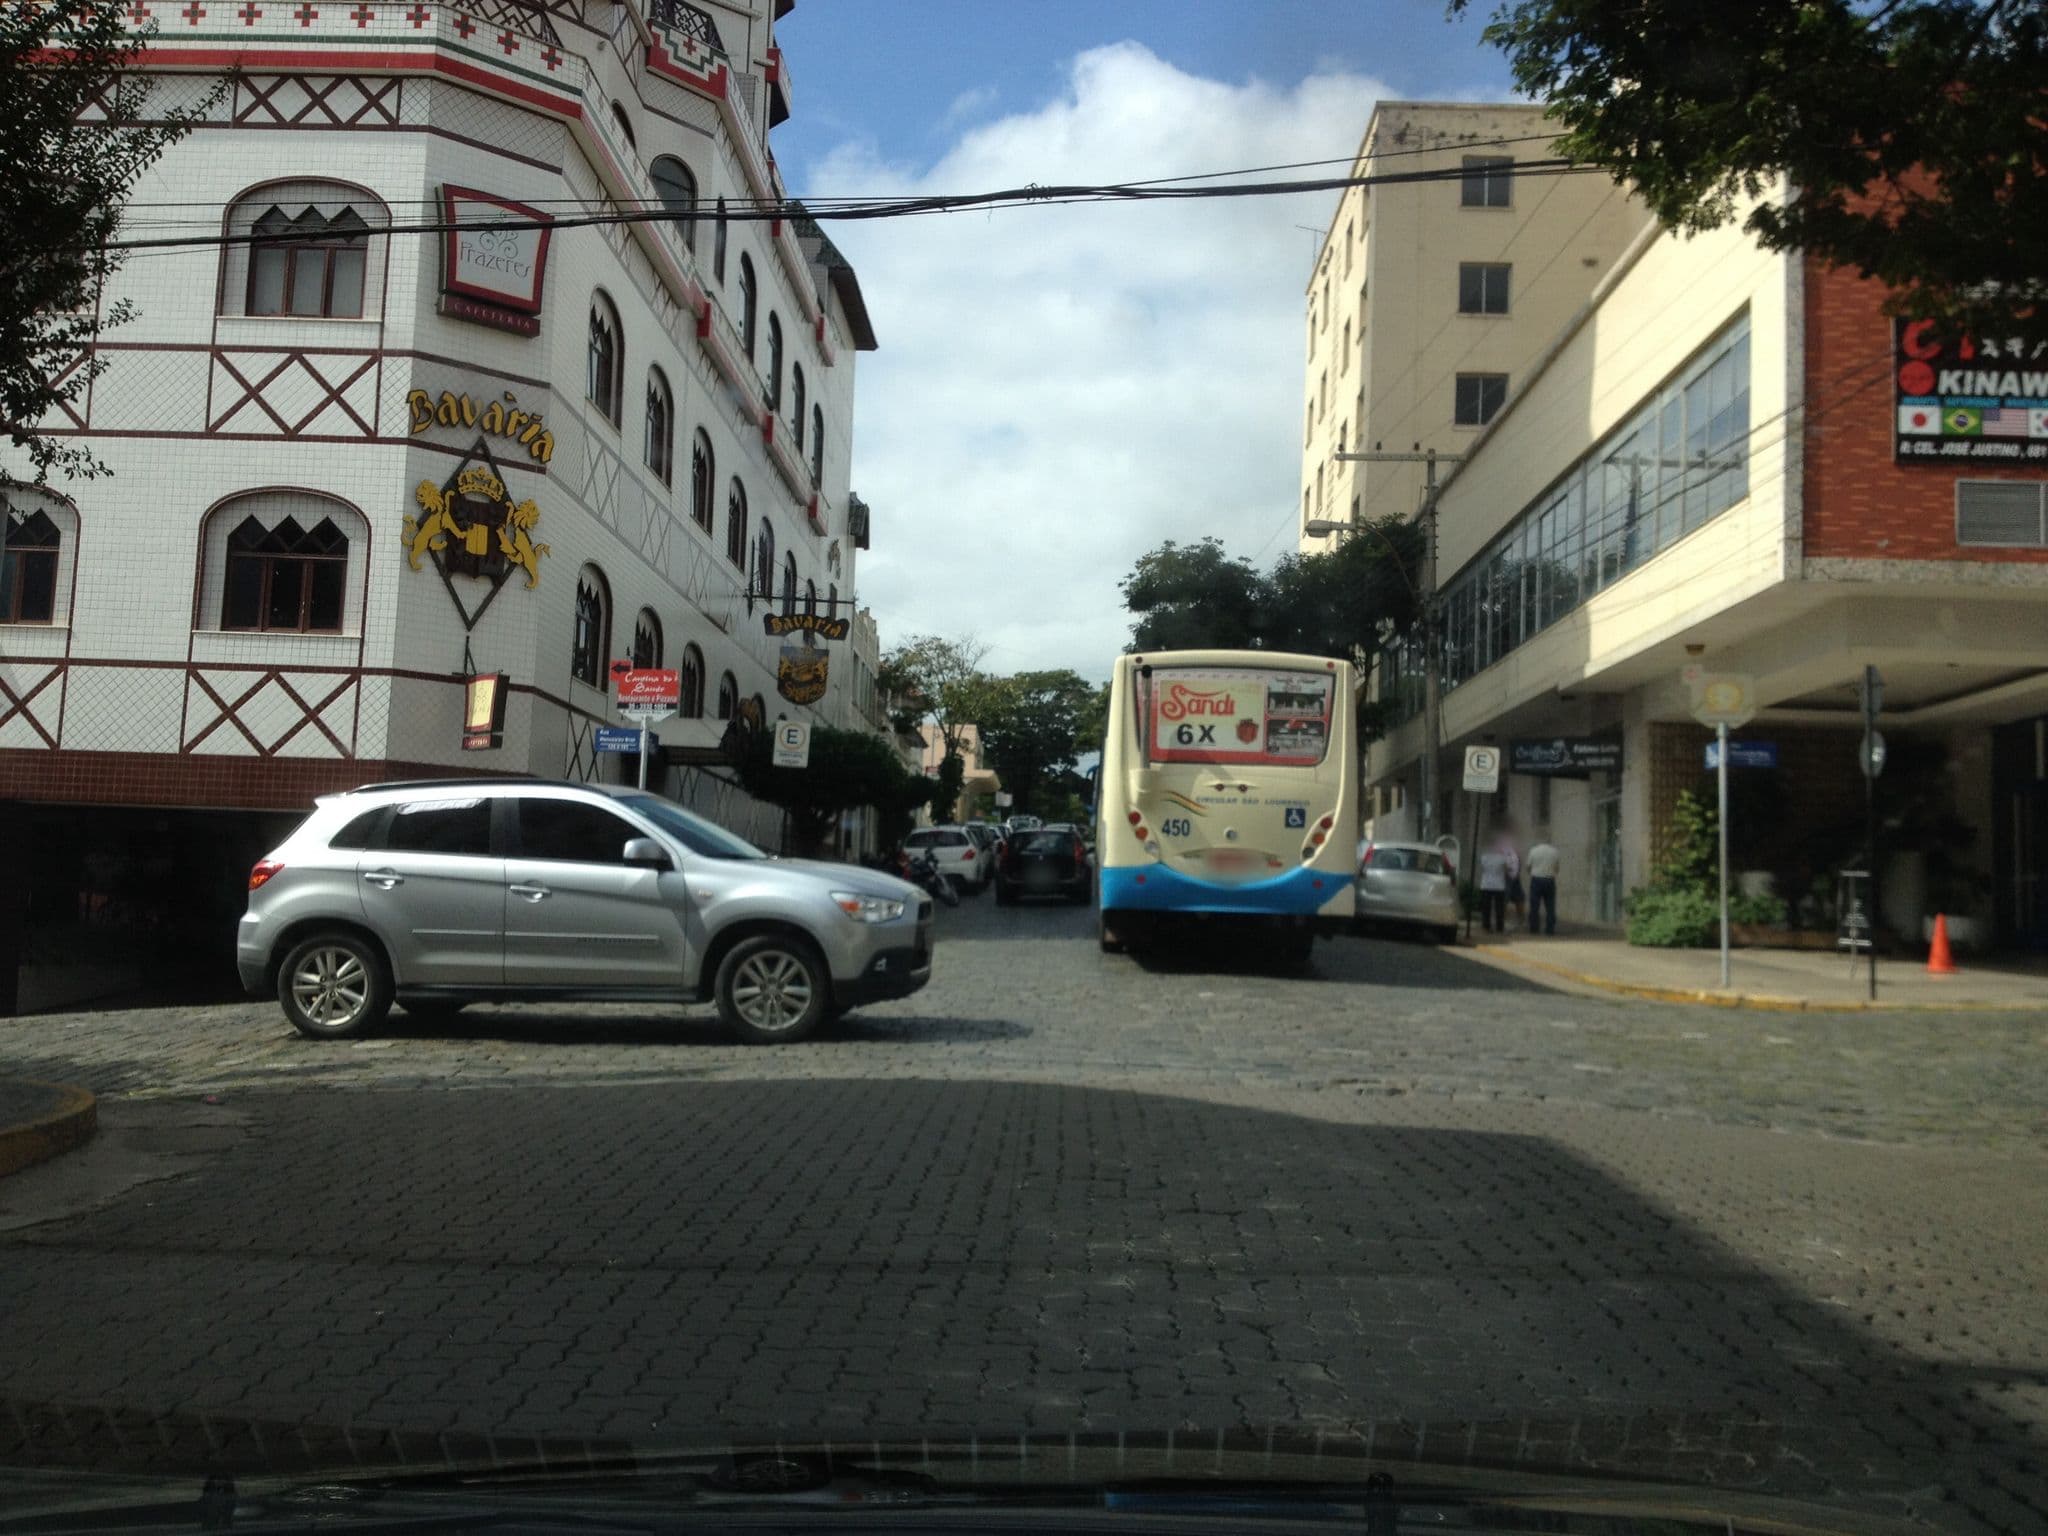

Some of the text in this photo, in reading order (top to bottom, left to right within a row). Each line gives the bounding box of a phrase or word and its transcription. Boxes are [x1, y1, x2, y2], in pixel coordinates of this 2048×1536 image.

[460, 241, 532, 279] Prazeres
[453, 302, 531, 329] CAFETERIA
[787, 728, 799, 744] E
[1476, 754, 1488, 769] E
[1195, 796, 1237, 805] CIRCULAR
[1161, 818, 1191, 838] 450
